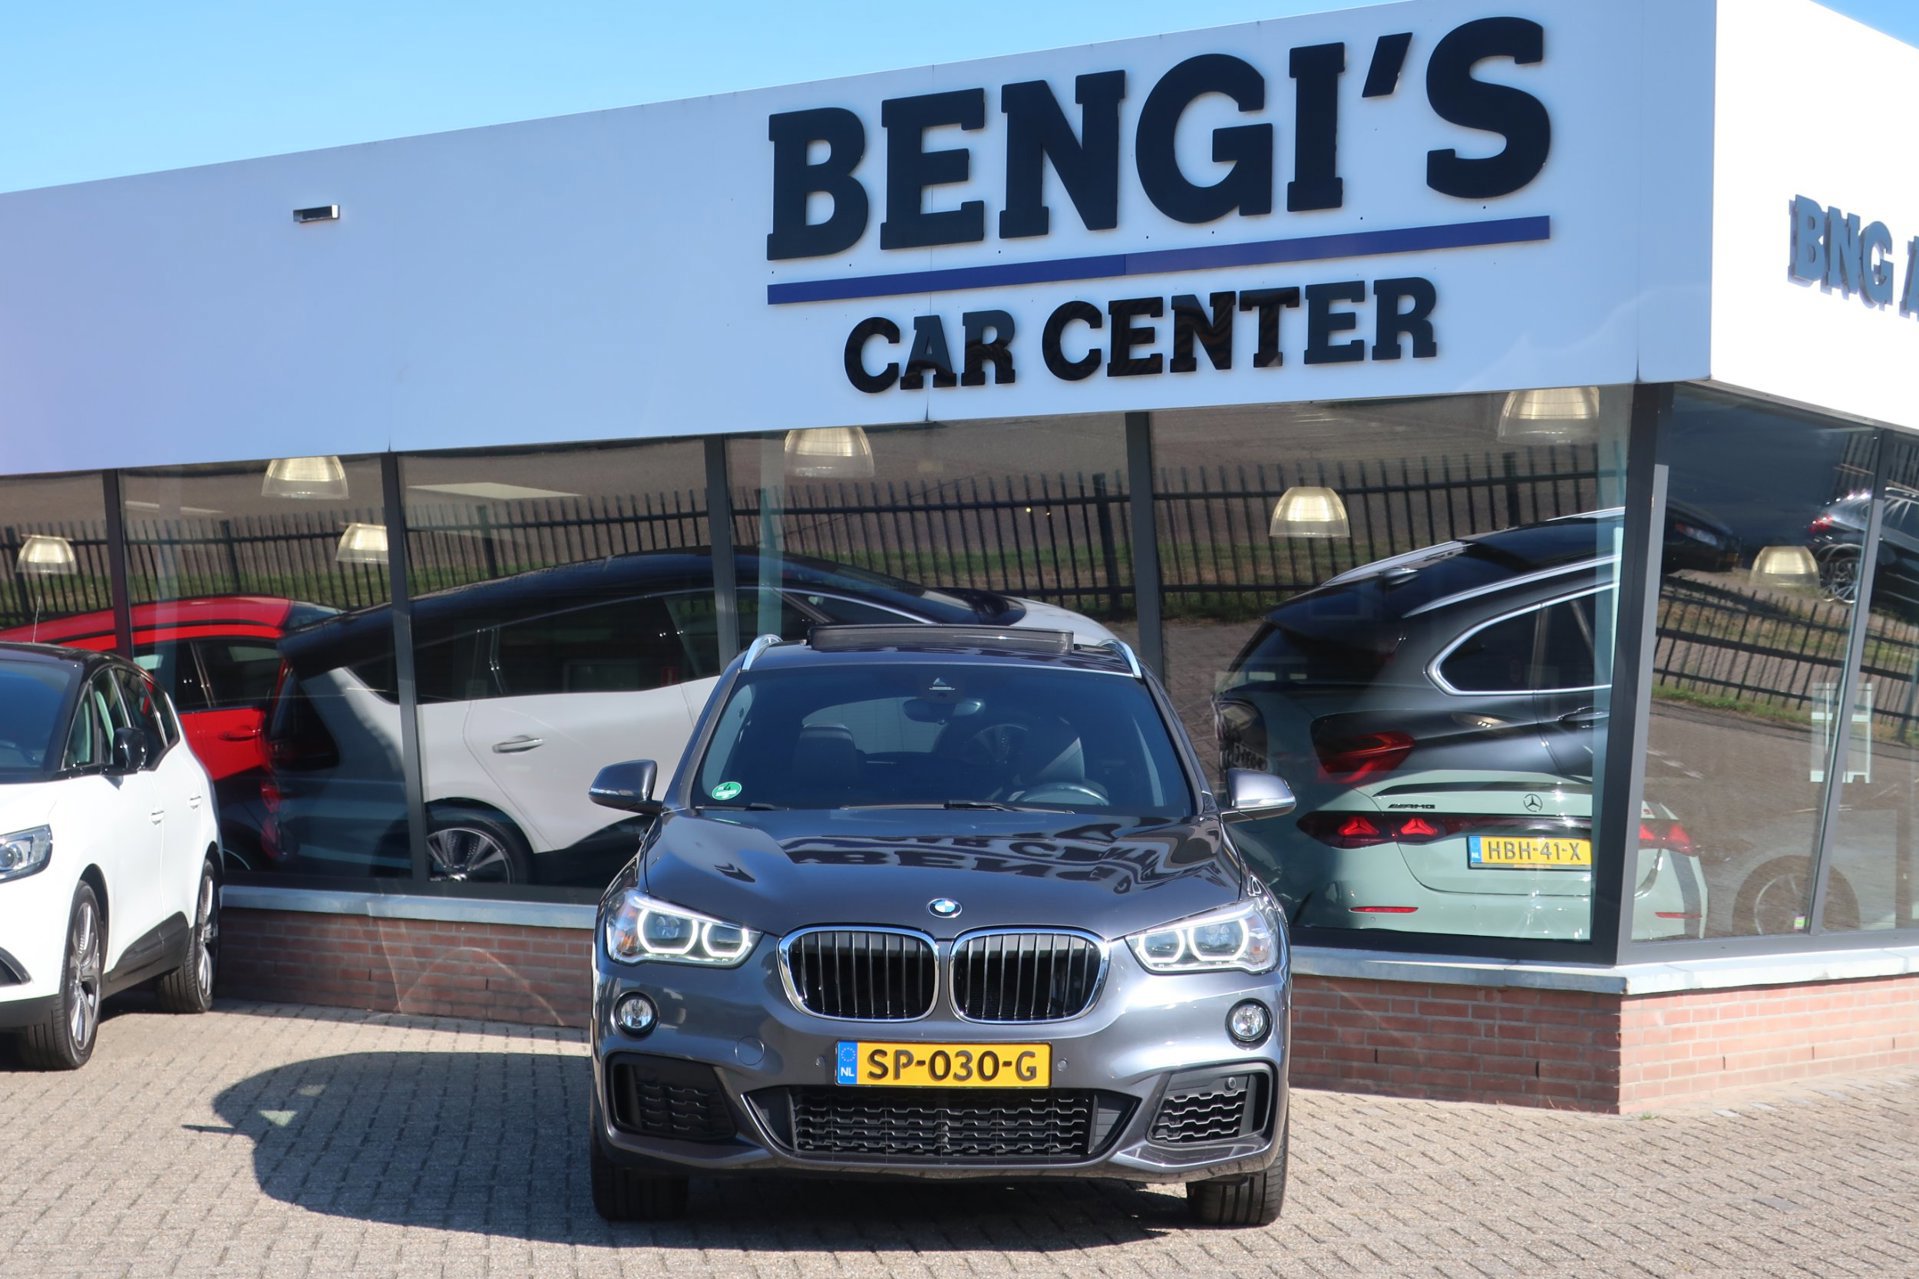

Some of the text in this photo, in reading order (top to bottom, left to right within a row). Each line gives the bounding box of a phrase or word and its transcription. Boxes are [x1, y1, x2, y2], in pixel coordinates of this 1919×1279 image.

[767, 17, 1551, 261] BENGI'S
[1788, 194, 1894, 308] BNG
[844, 277, 1437, 393] CAR CENTER
[1488, 841, 1581, 860] HBH-41-X
[840, 1049, 1037, 1081] NL SP-030-G
